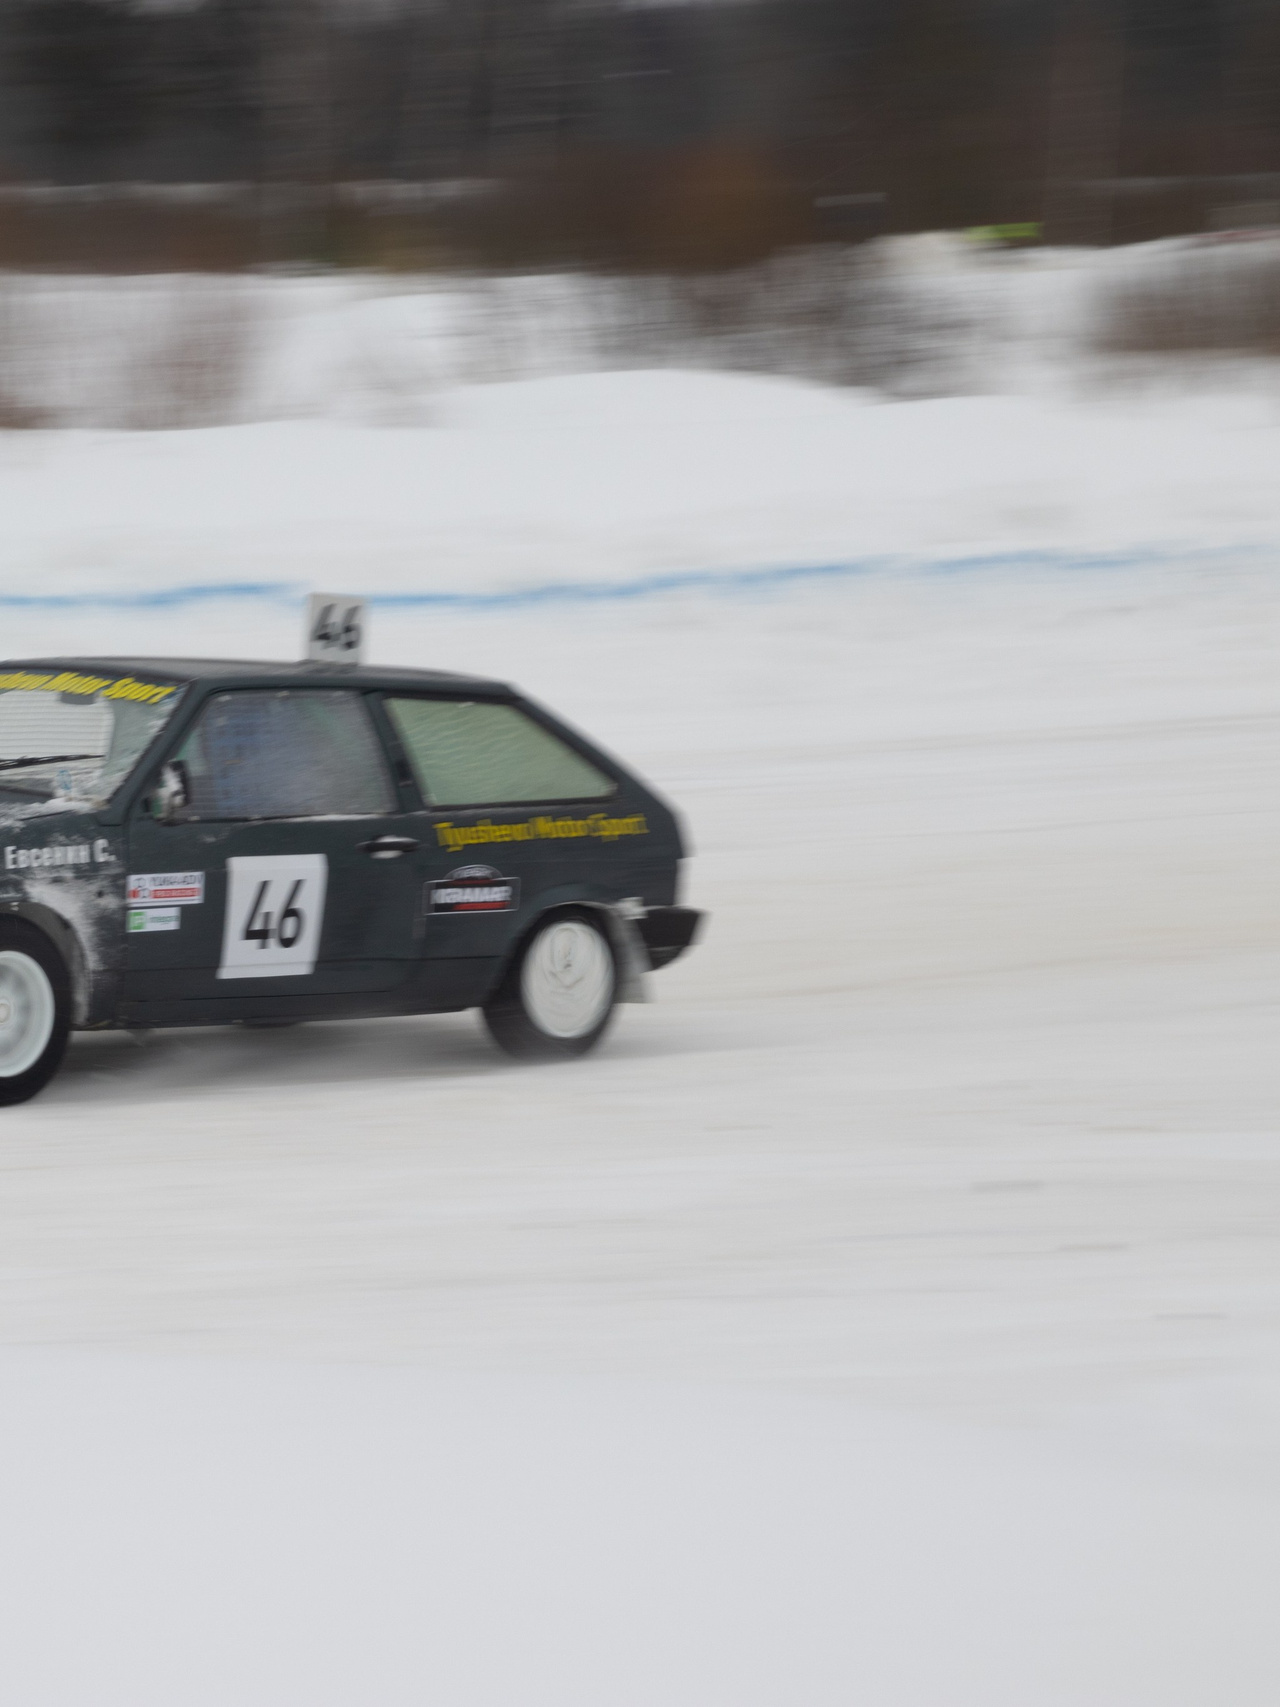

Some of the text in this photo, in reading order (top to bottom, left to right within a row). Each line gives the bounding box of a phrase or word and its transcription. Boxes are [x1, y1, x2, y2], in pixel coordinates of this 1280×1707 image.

[310, 603, 363, 652] 46
[40, 672, 114, 696] Motor
[101, 677, 178, 704] Sport
[530, 815, 593, 840] Motor
[590, 813, 650, 843] Sport
[240, 879, 307, 950] 46
